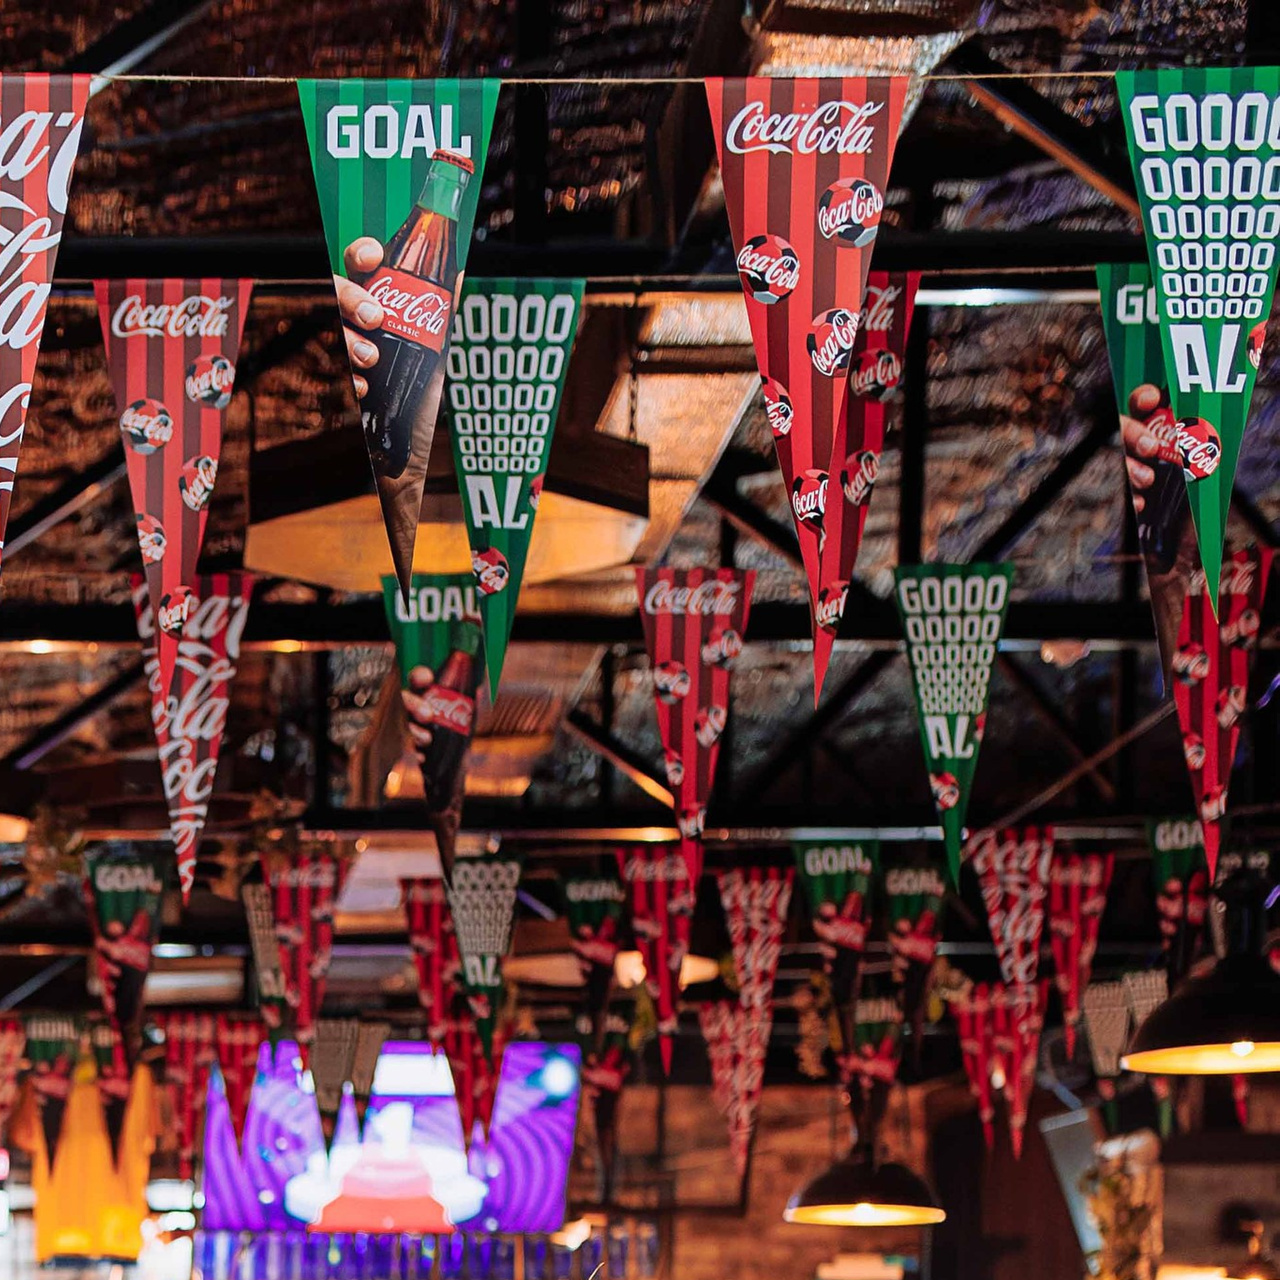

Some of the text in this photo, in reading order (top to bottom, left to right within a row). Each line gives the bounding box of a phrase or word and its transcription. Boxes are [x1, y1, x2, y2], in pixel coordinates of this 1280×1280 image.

[327, 105, 471, 159] GOAL
[726, 101, 884, 155] Coca-Cola
[111, 295, 235, 338] Coca-Cola
[367, 276, 451, 335] Coca-Cola
[387, 320, 420, 338] CLASSIC
[1169, 323, 1247, 393] AL
[465, 474, 529, 529] AL
[899, 575, 1008, 614] GOOOO
[924, 715, 974, 760] AL
